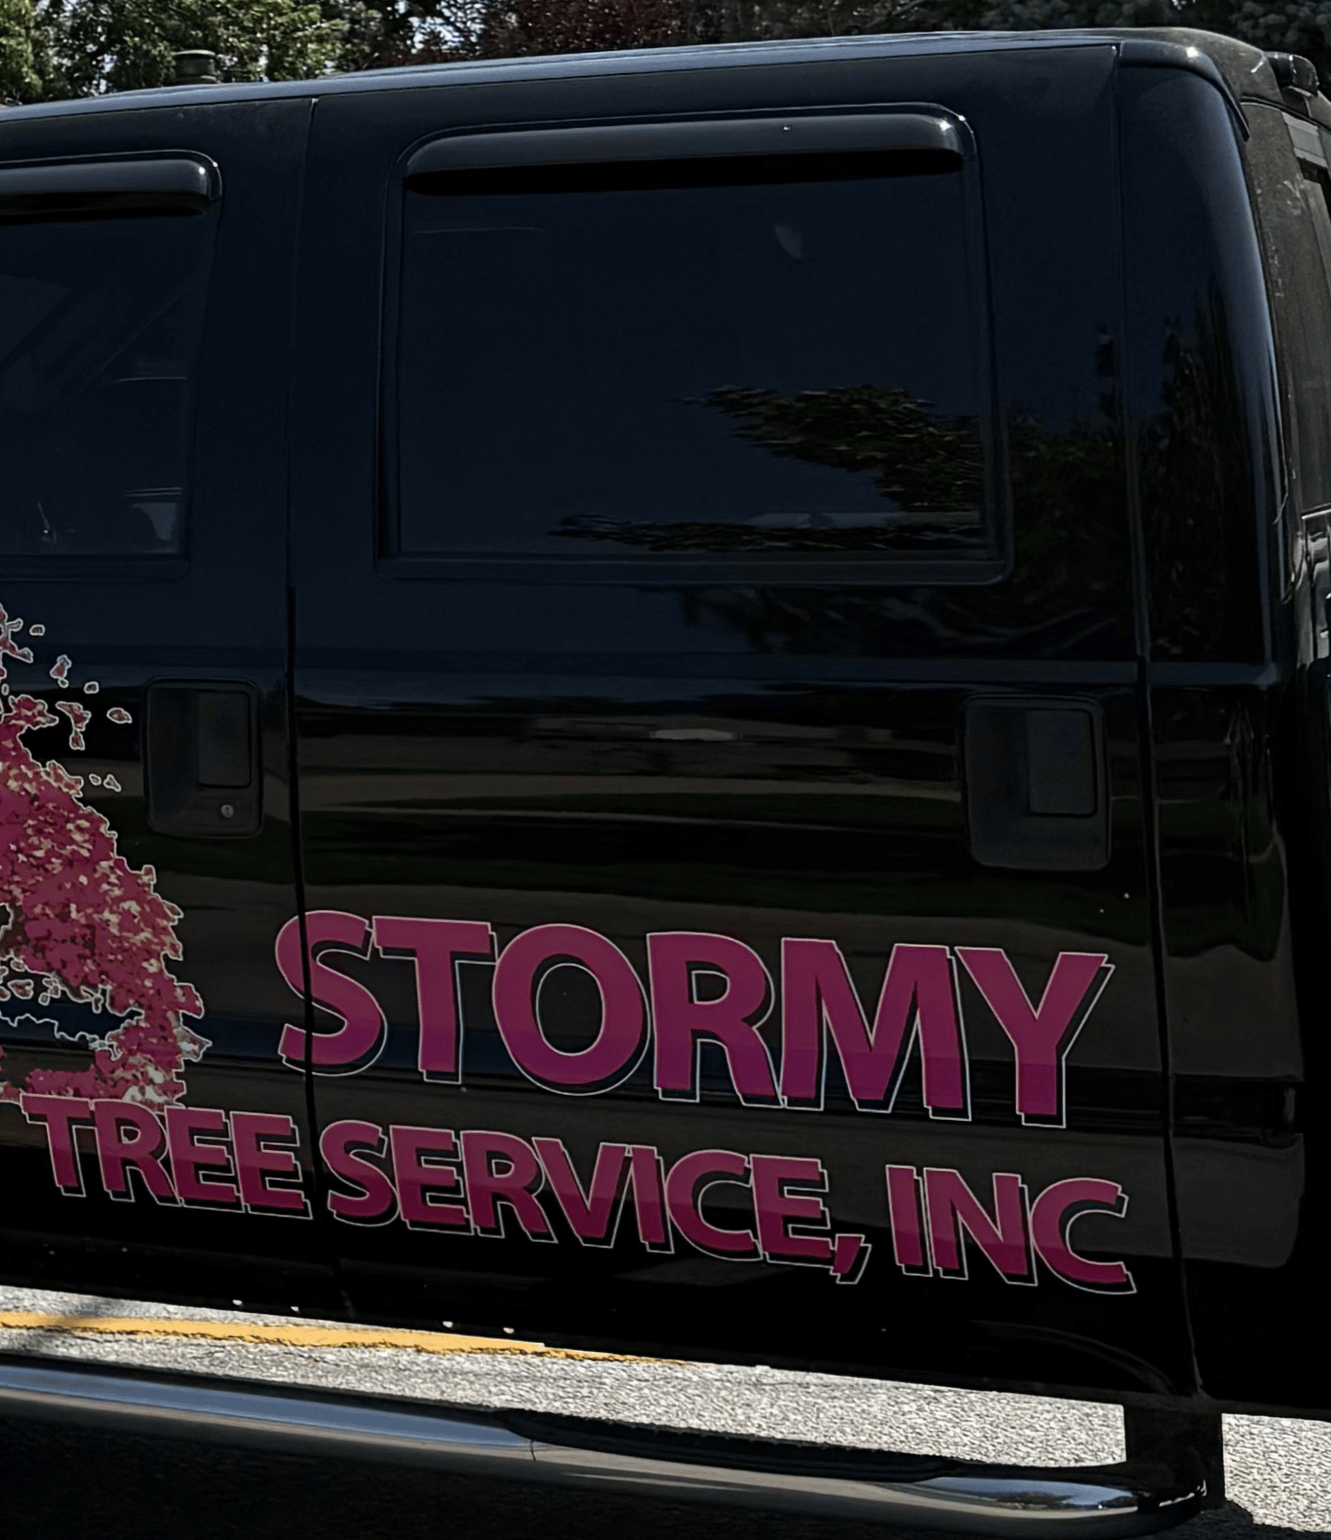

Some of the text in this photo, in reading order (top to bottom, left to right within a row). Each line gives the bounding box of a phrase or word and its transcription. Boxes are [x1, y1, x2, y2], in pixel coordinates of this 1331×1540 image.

[274, 909, 1115, 1129] STORMY
[20, 1093, 1138, 1295] TREE SERVICE, INC
